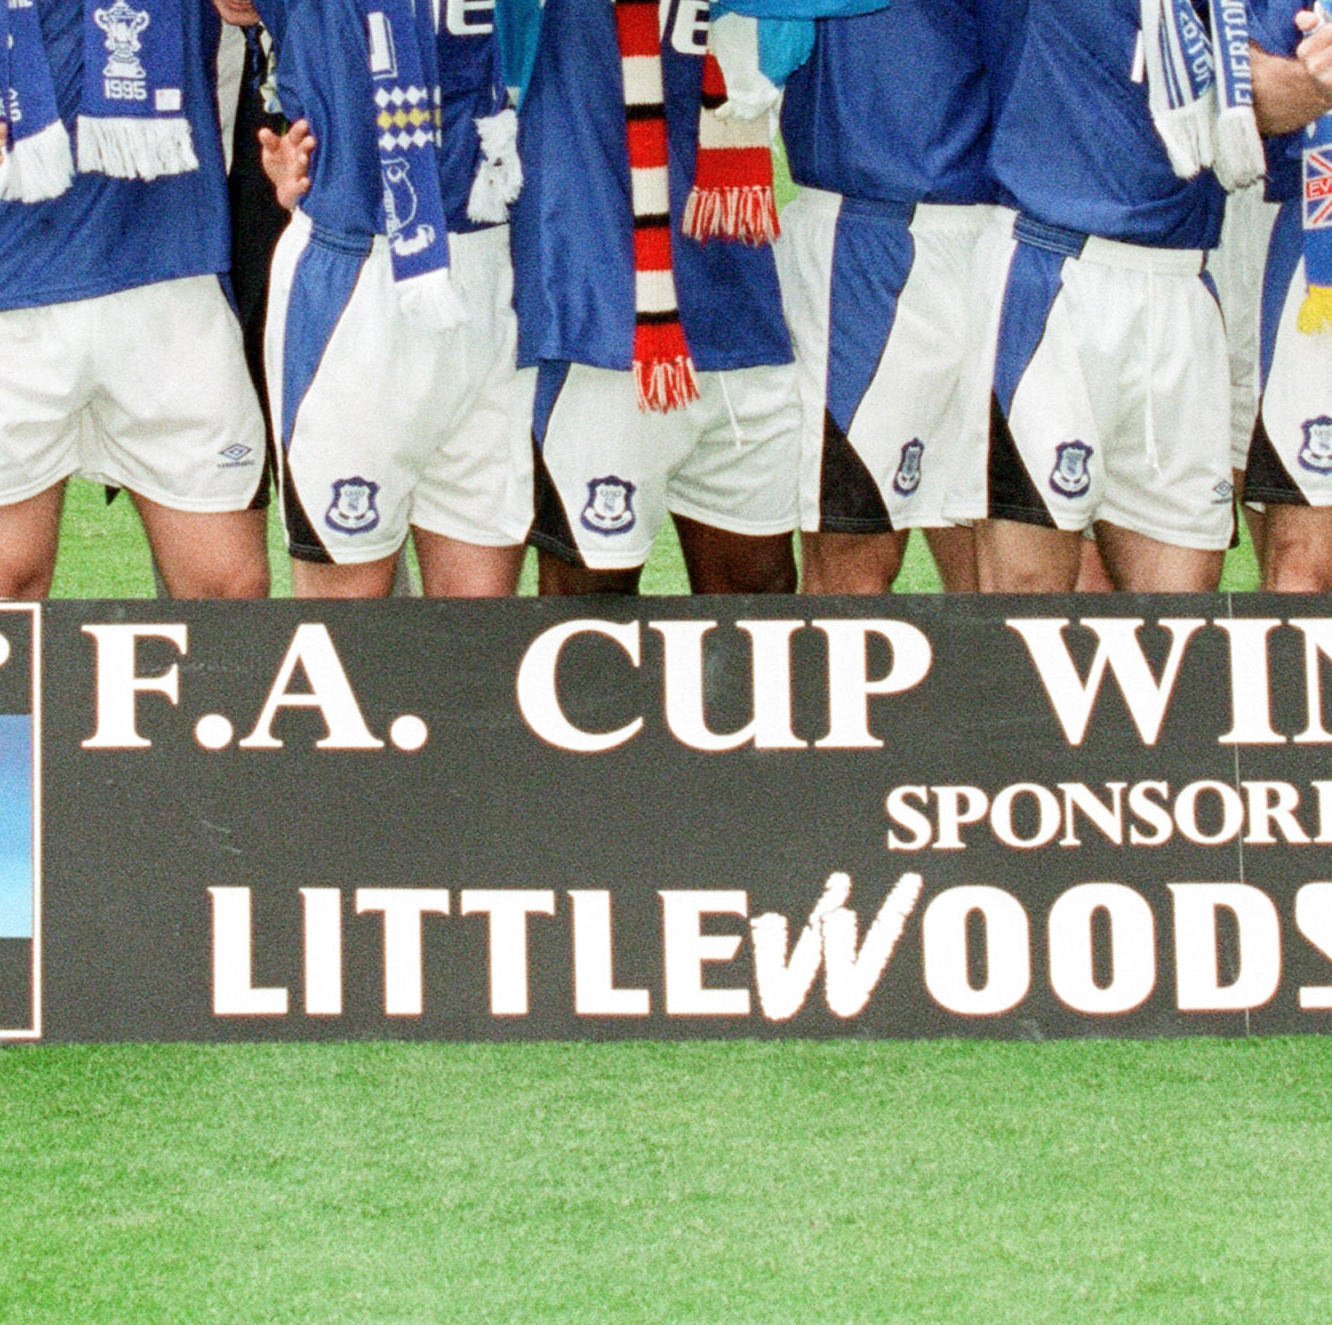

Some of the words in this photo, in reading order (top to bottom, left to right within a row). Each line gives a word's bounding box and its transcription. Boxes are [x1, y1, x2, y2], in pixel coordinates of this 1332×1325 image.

[104, 80, 147, 101] 1995
[80, 622, 429, 751] F.A.
[516, 619, 933, 752] CUP
